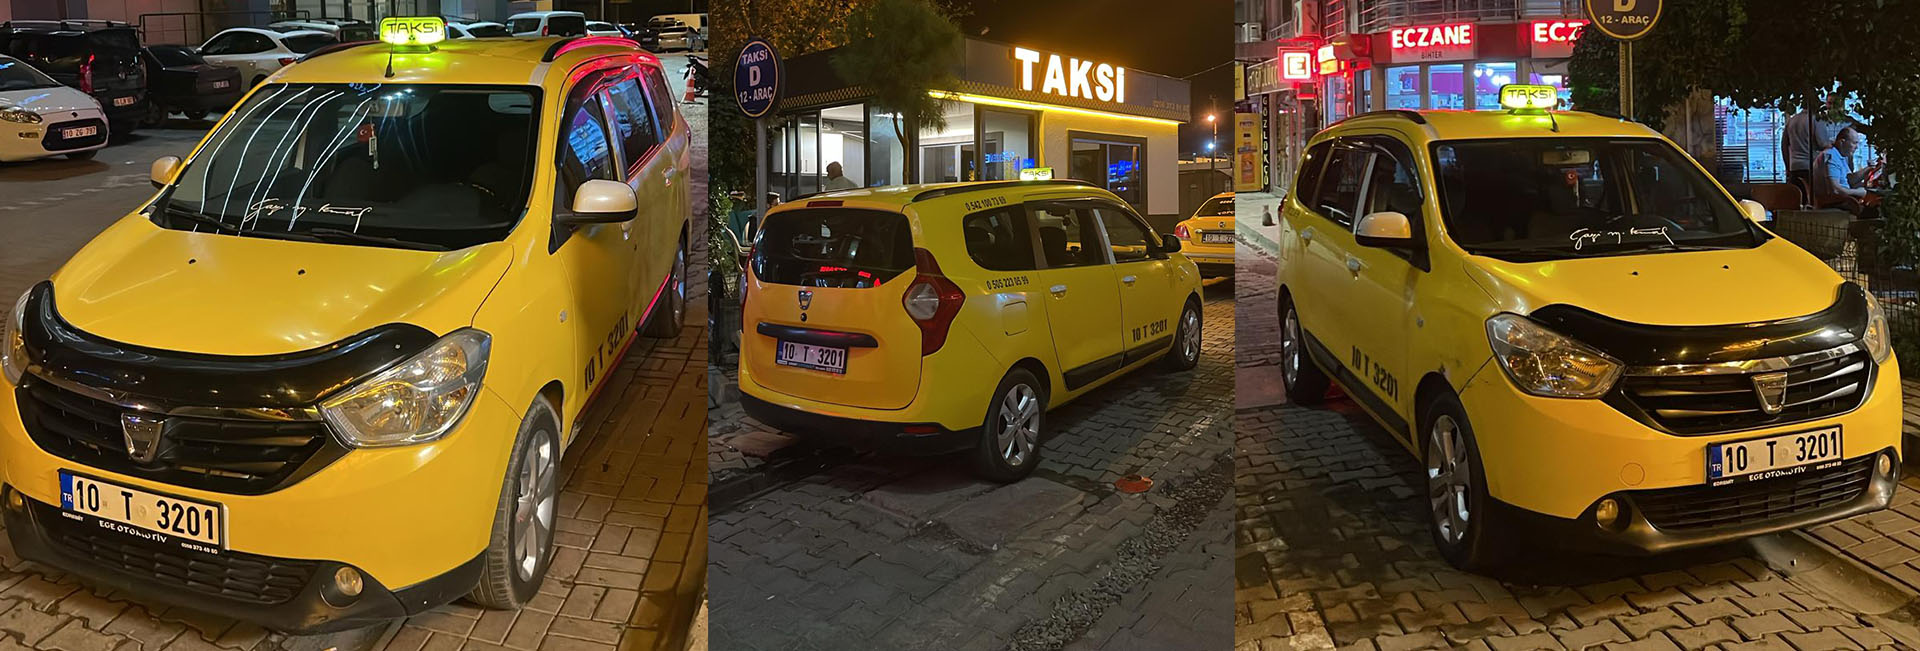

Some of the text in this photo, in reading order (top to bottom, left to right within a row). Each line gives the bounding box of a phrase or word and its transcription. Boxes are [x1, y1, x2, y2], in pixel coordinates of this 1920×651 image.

[1600, 15, 1613, 24] 12
[1621, 15, 1650, 26] ARAÇ
[1391, 25, 1471, 48] ECZANE
[749, 65, 761, 87] D
[1288, 56, 1307, 76] E
[739, 91, 748, 104] 12
[753, 86, 773, 102] ARAÇ
[965, 202, 971, 211] 0
[986, 280, 992, 290] 0
[1131, 318, 1168, 343] 10 T 3201
[584, 310, 629, 392] 10 T 3201
[784, 343, 796, 360] 10
[803, 346, 810, 362] T
[817, 347, 844, 368] 3201
[1351, 344, 1399, 403] 10 T 3201
[1711, 431, 1837, 473] TR 10 T 3201
[1748, 472, 1764, 482] EGE
[63, 480, 214, 540] TR 10 T 3201
[99, 520, 116, 531] EGE
